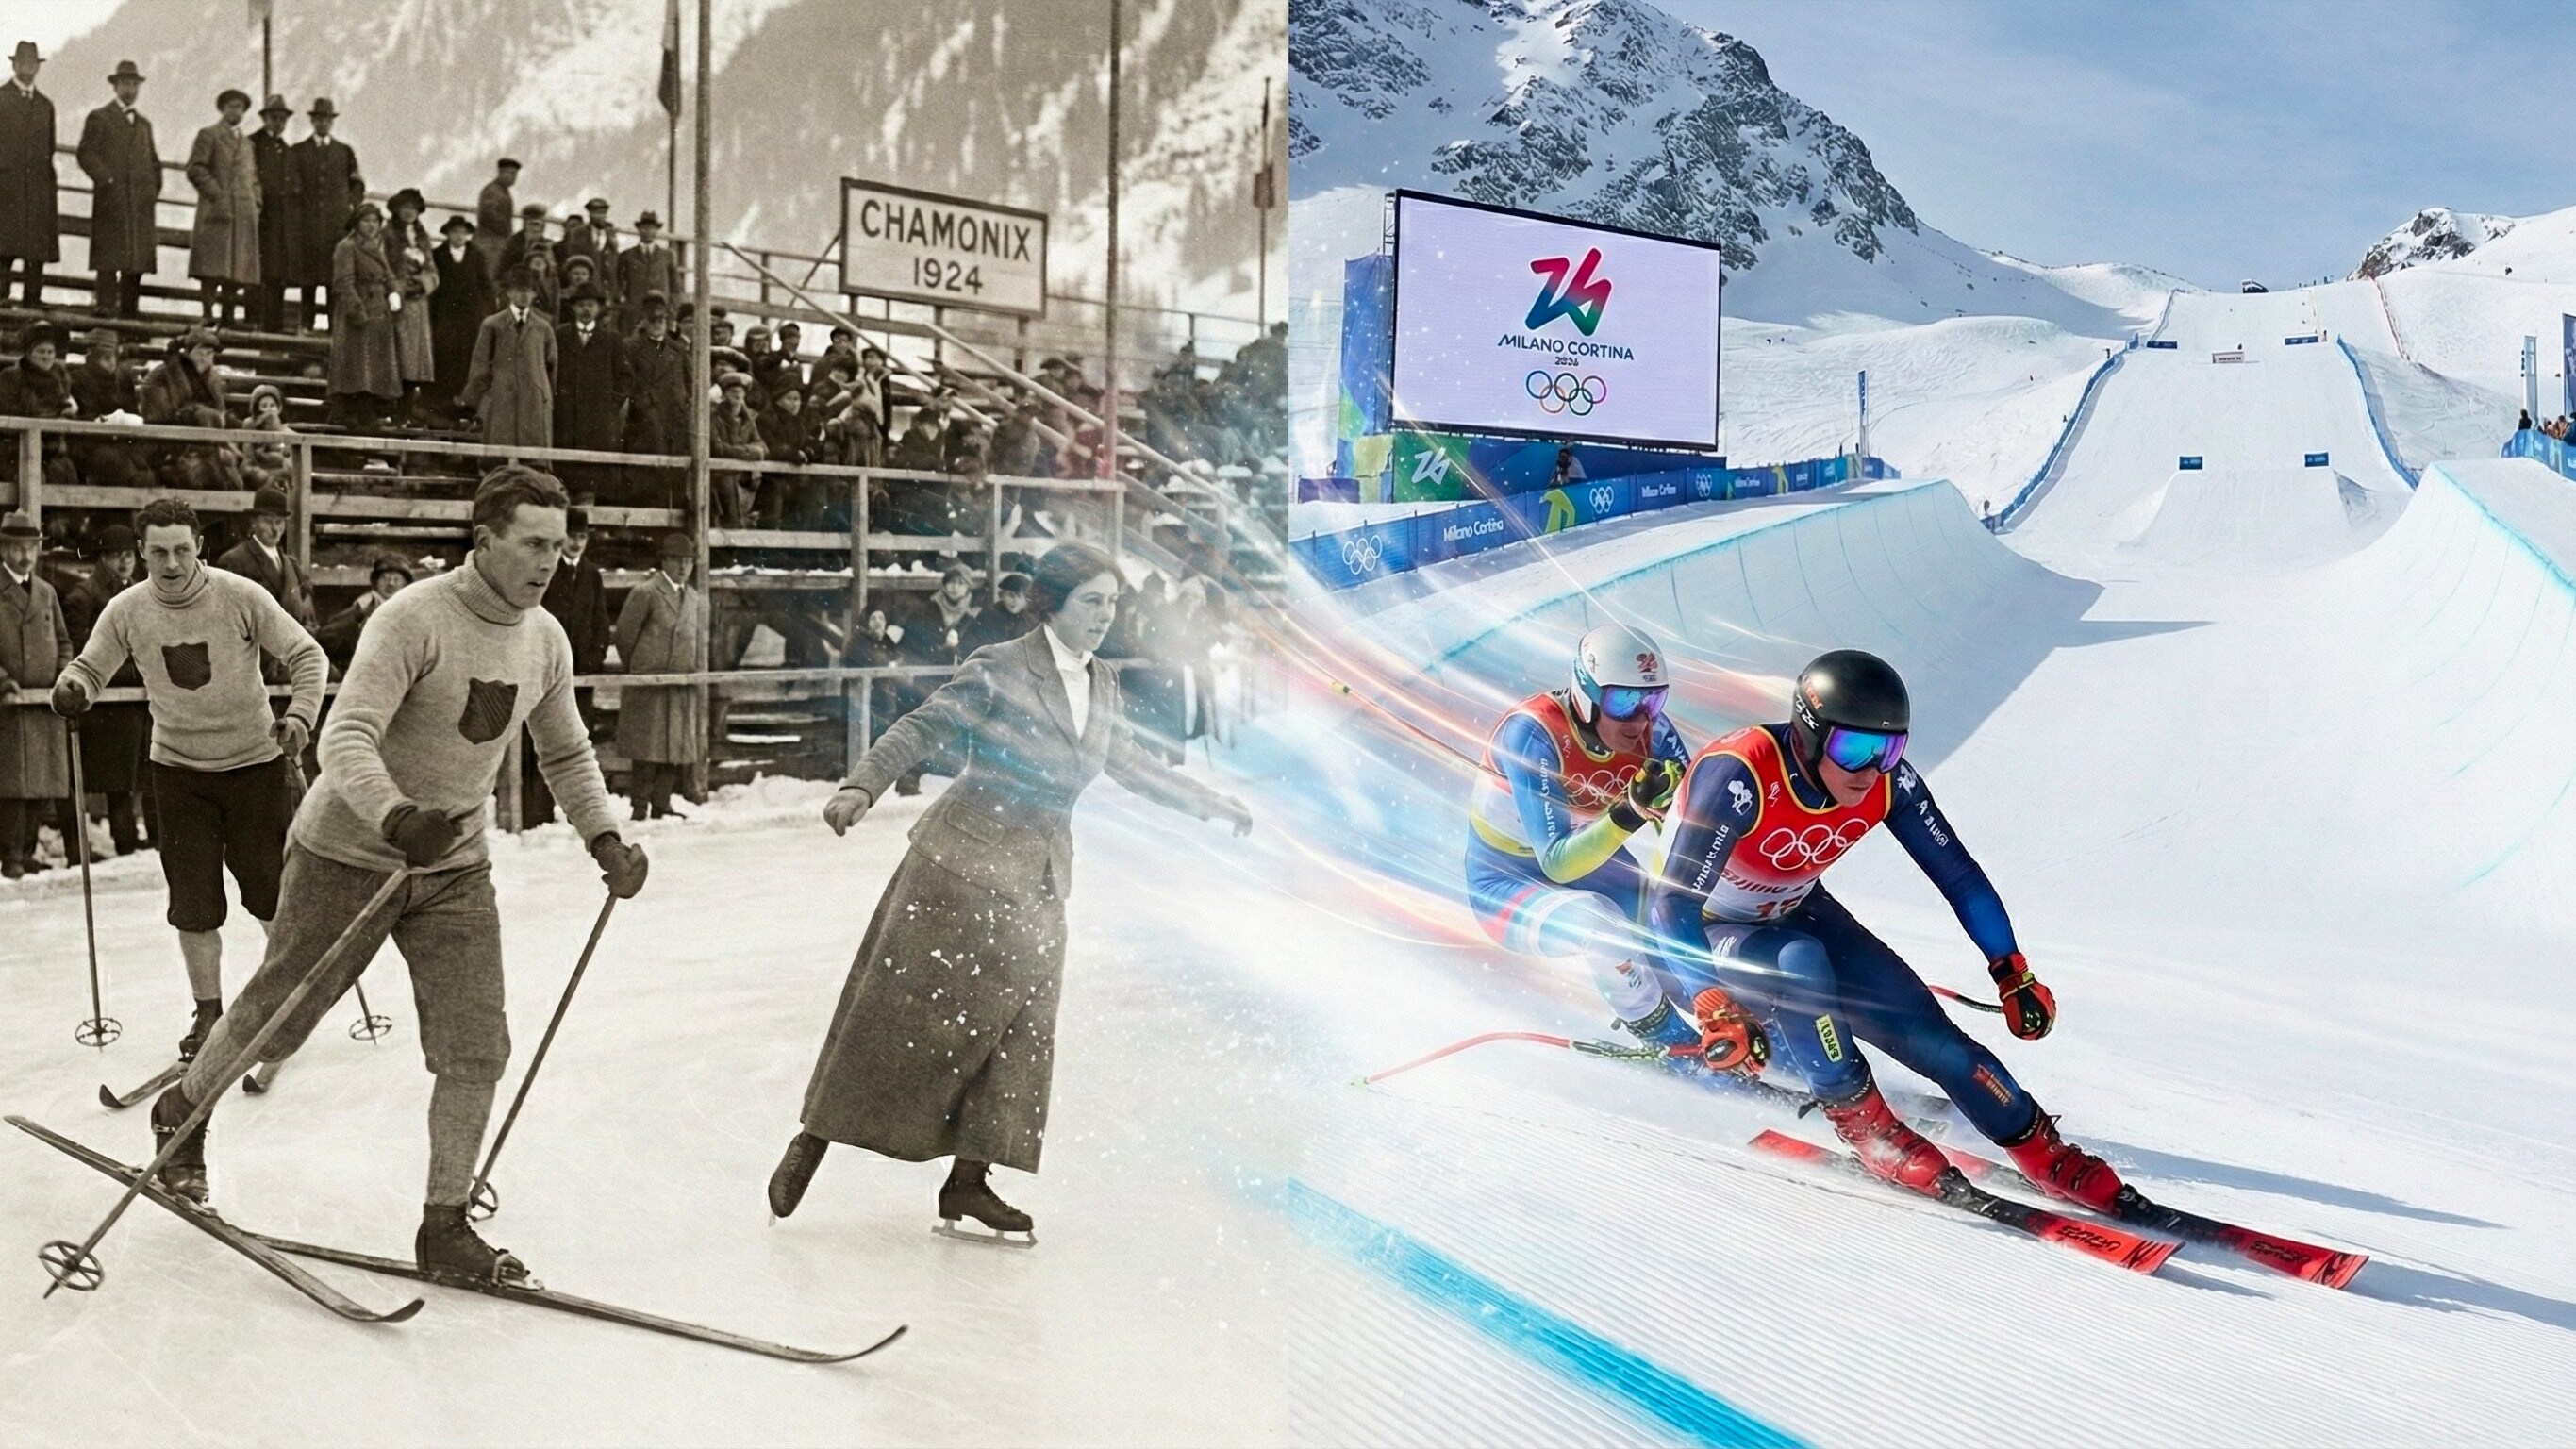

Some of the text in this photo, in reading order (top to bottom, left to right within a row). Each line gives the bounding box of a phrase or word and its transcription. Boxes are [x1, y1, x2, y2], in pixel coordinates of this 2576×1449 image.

[861, 199, 1031, 263] CHAMONIX
[914, 256, 984, 296] 1924
[1497, 333, 1635, 361] MILANO CORTINA
